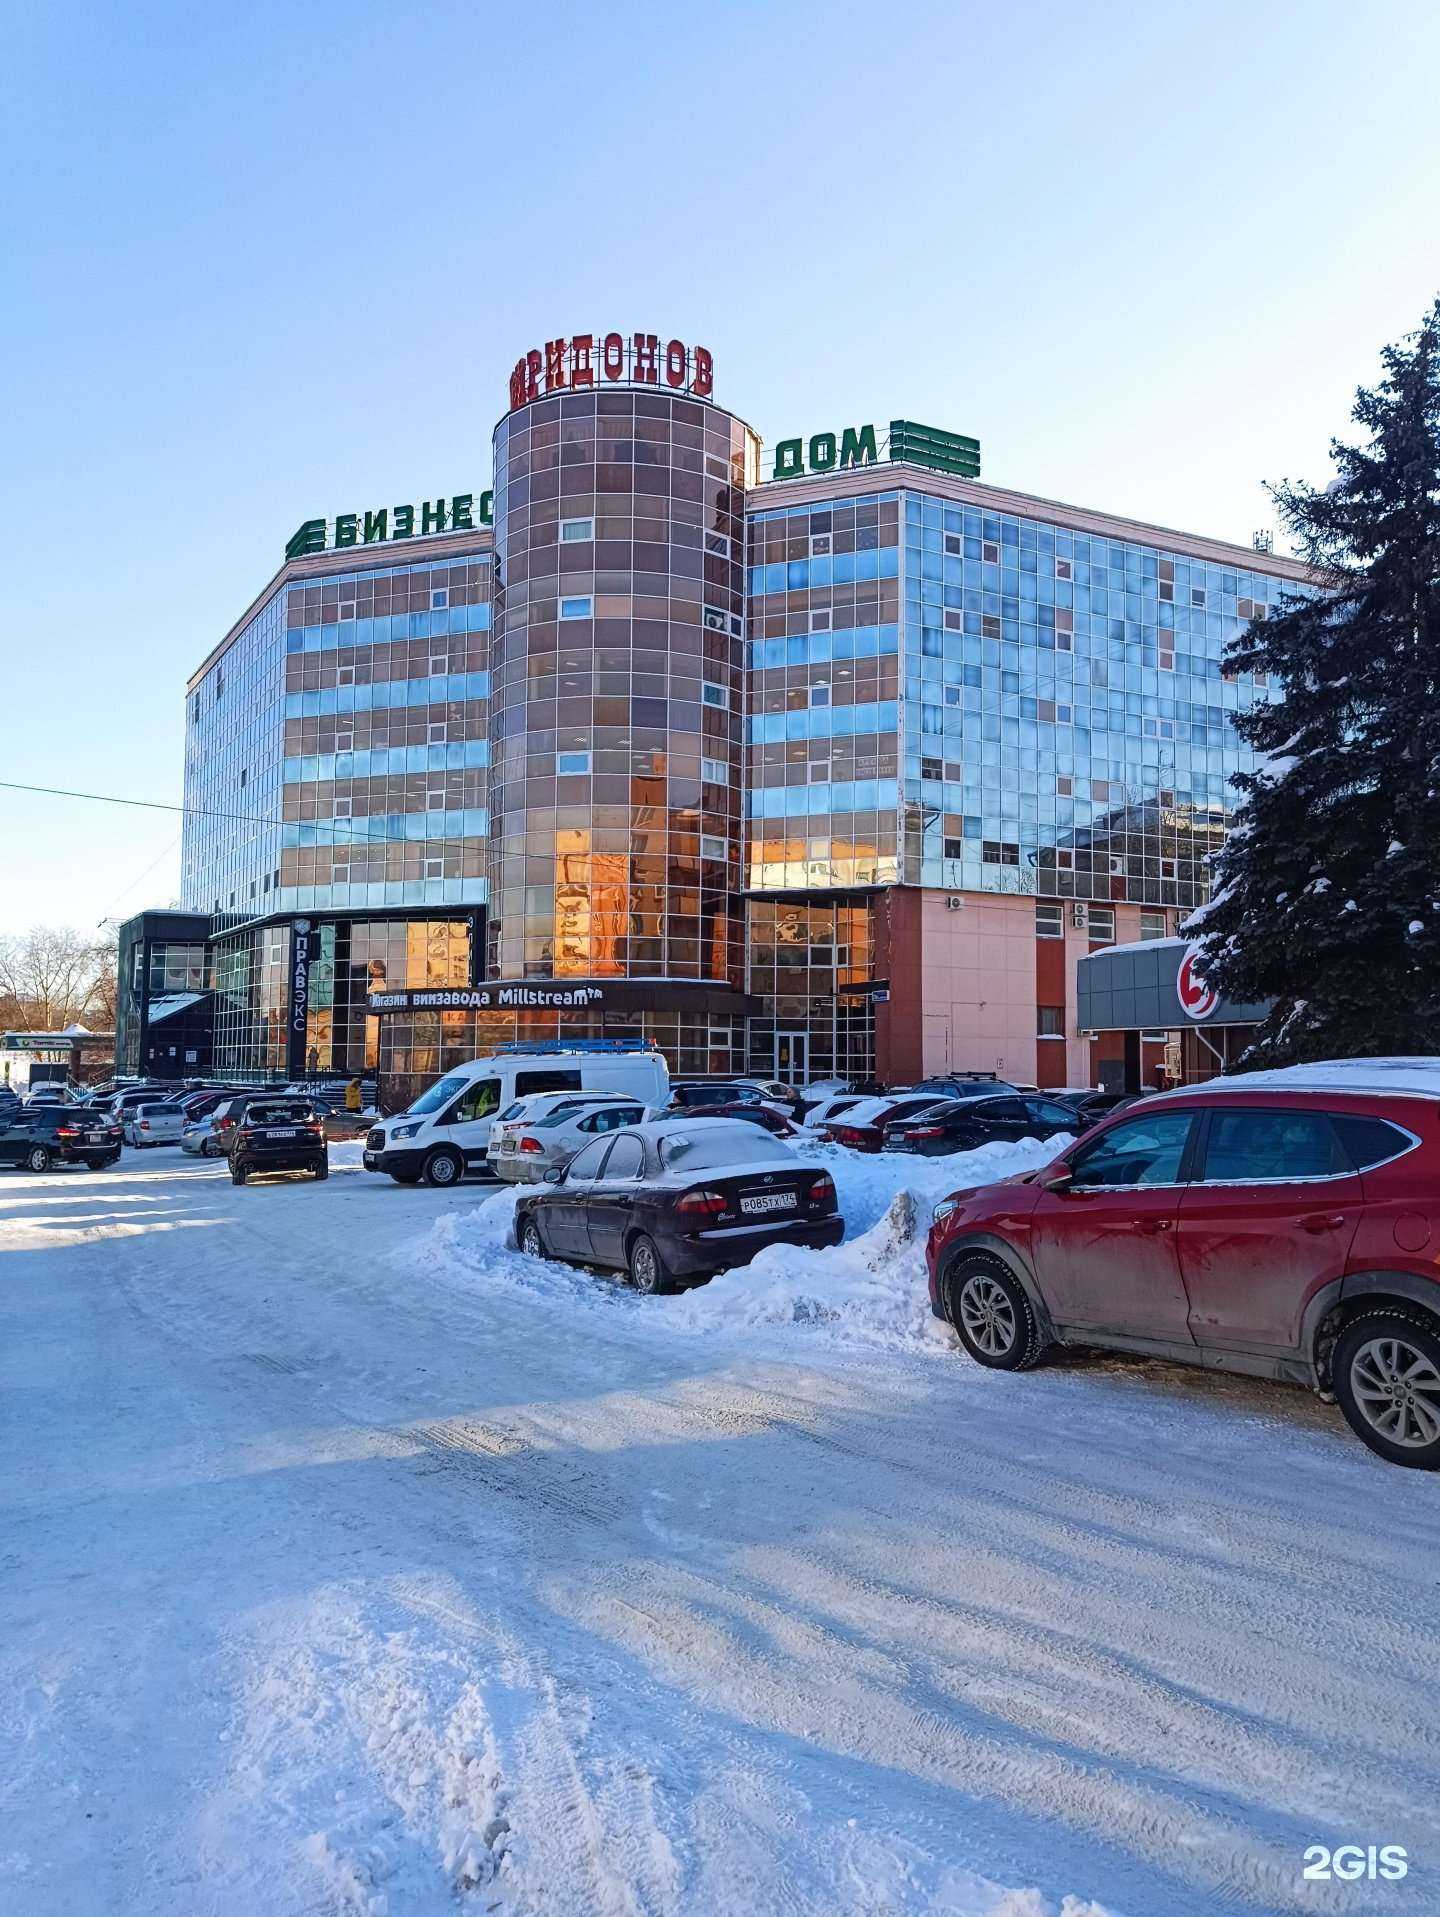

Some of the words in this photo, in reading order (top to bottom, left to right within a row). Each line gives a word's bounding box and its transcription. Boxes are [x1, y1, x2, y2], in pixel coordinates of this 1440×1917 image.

[773, 424, 878, 480] ДОМ
[293, 936, 309, 1031] ПРАВЭКС
[413, 991, 491, 1007] винзавода
